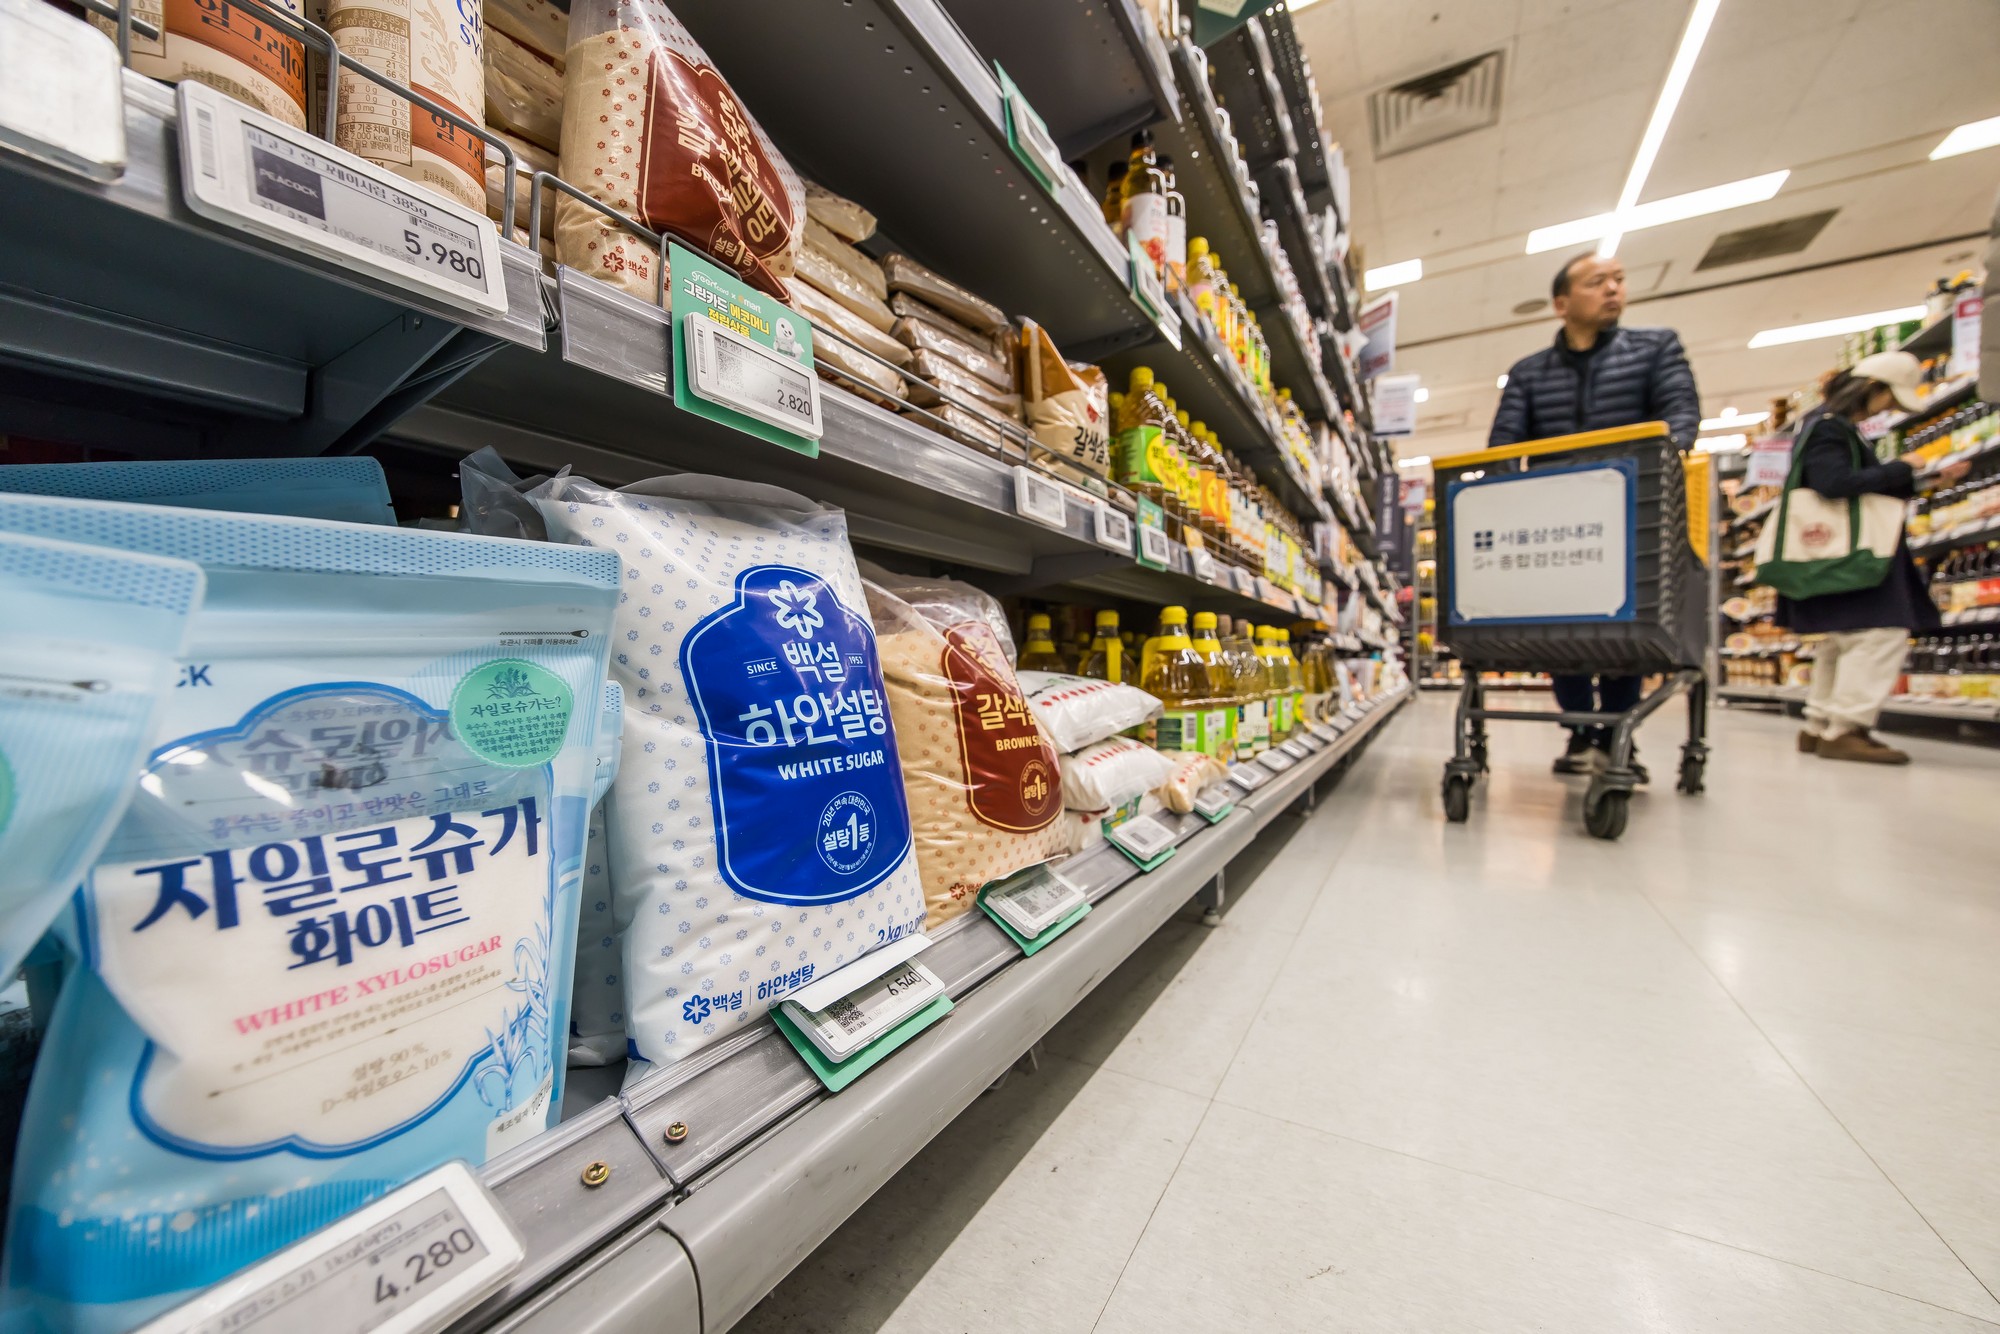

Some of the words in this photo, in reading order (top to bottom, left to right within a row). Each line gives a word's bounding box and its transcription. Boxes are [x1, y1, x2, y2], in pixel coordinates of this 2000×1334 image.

[372, 20, 388, 30] 275
[389, 23, 408, 37] kcal
[386, 60, 396, 69] 21
[386, 69, 396, 79] 66
[246, 75, 270, 97] 385
[373, 133, 391, 142] kcal
[258, 168, 319, 199] PEACOCK
[403, 229, 482, 280] 5.980
[628, 260, 648, 280] 백설
[683, 277, 728, 313] 그린카드
[729, 302, 770, 336] 에코머니
[777, 388, 811, 416] 2.820
[1499, 547, 1604, 571] 종합검진센터
[545, 637, 579, 646] 이용하세요
[746, 660, 778, 676] SINCE
[848, 655, 864, 666] 1953
[781, 641, 847, 684] 백설
[470, 695, 562, 718] 자일로슈가는?
[738, 689, 887, 748] 하얀설탕
[995, 735, 1033, 752] BROWN
[778, 756, 844, 781] WHITE
[845, 748, 885, 772] SUGAR
[433, 779, 492, 804] 그대로
[822, 805, 837, 828] 20년
[133, 797, 541, 932] 자일로슈가
[287, 884, 471, 969] 화이트
[232, 986, 349, 1036] WHITE
[355, 935, 502, 999] XYLOSUGAR
[712, 989, 743, 1013] 백설
[757, 962, 816, 1001] 하얀설탕
[373, 1228, 475, 1306] 4.280
